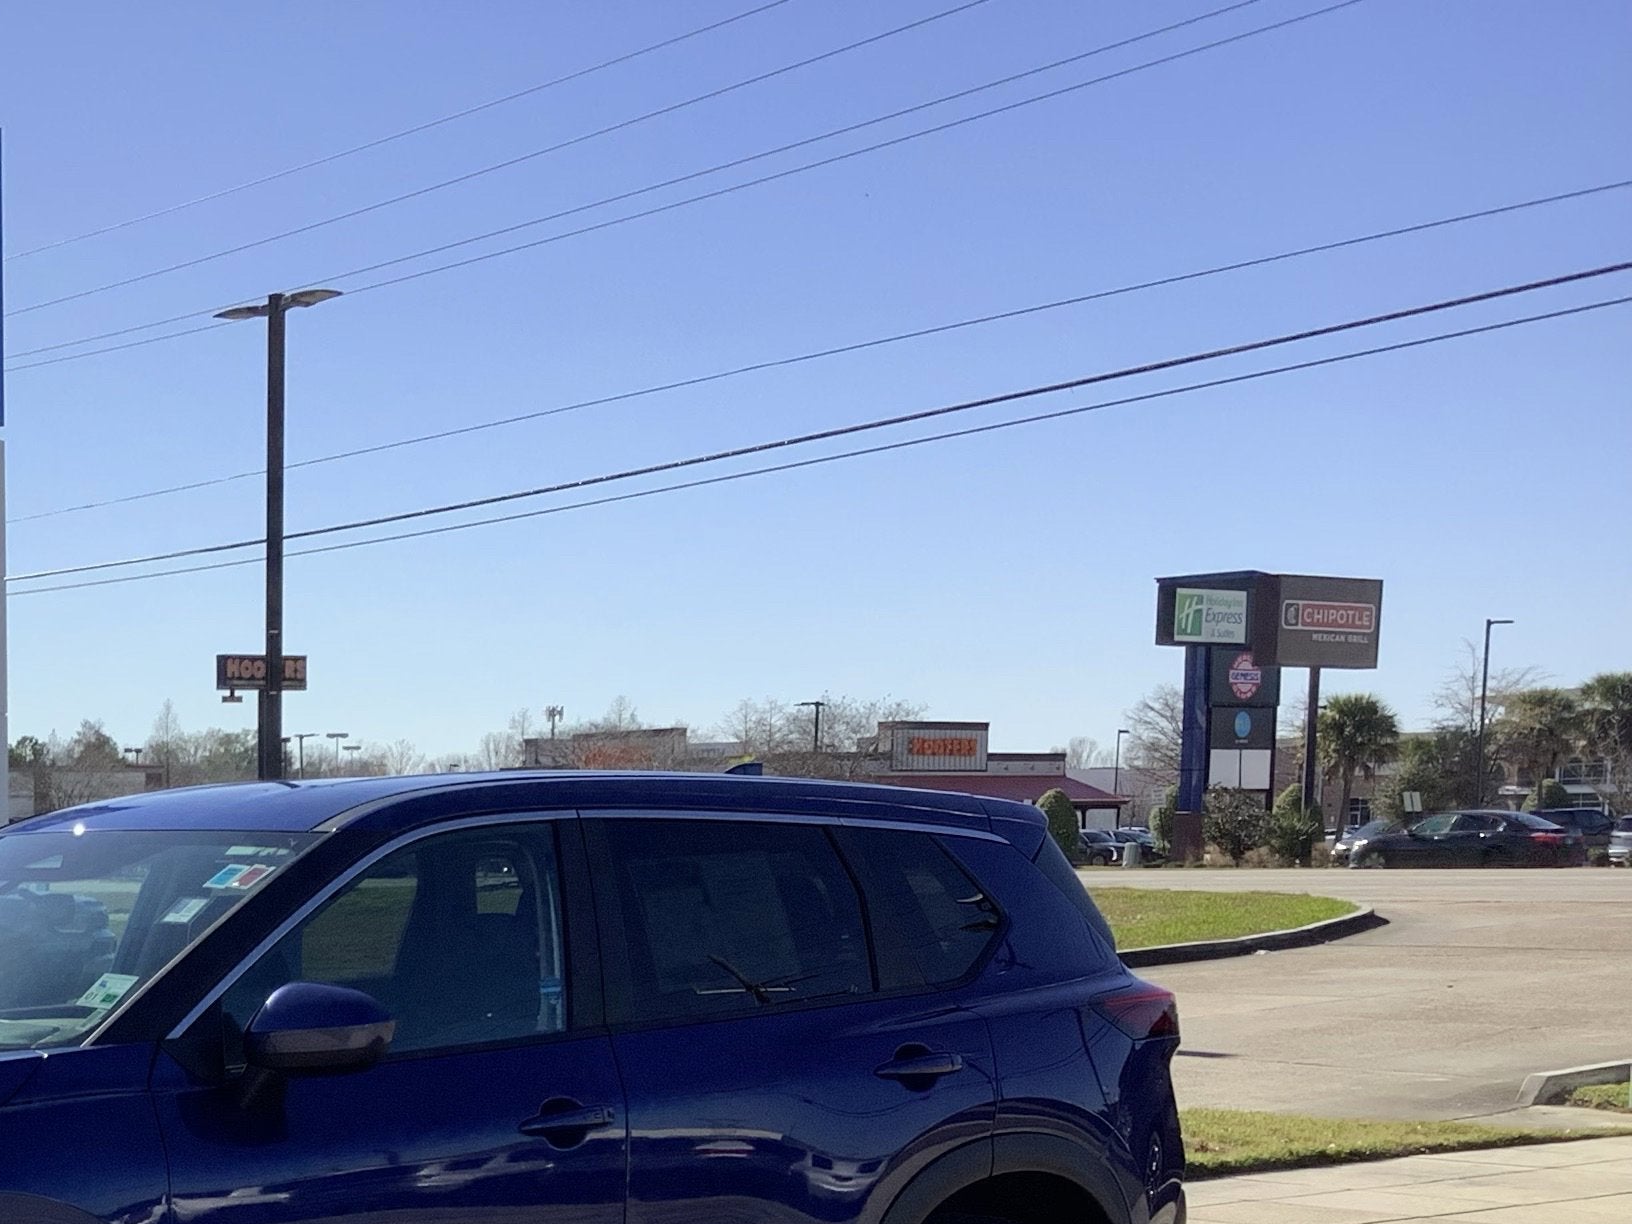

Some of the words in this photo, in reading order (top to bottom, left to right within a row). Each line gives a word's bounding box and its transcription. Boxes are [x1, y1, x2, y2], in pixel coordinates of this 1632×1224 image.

[1204, 607, 1244, 627] Express
[1303, 608, 1371, 625] CHIPOTLE
[1311, 633, 1345, 643] MEXICAN
[226, 658, 305, 680] HOORS
